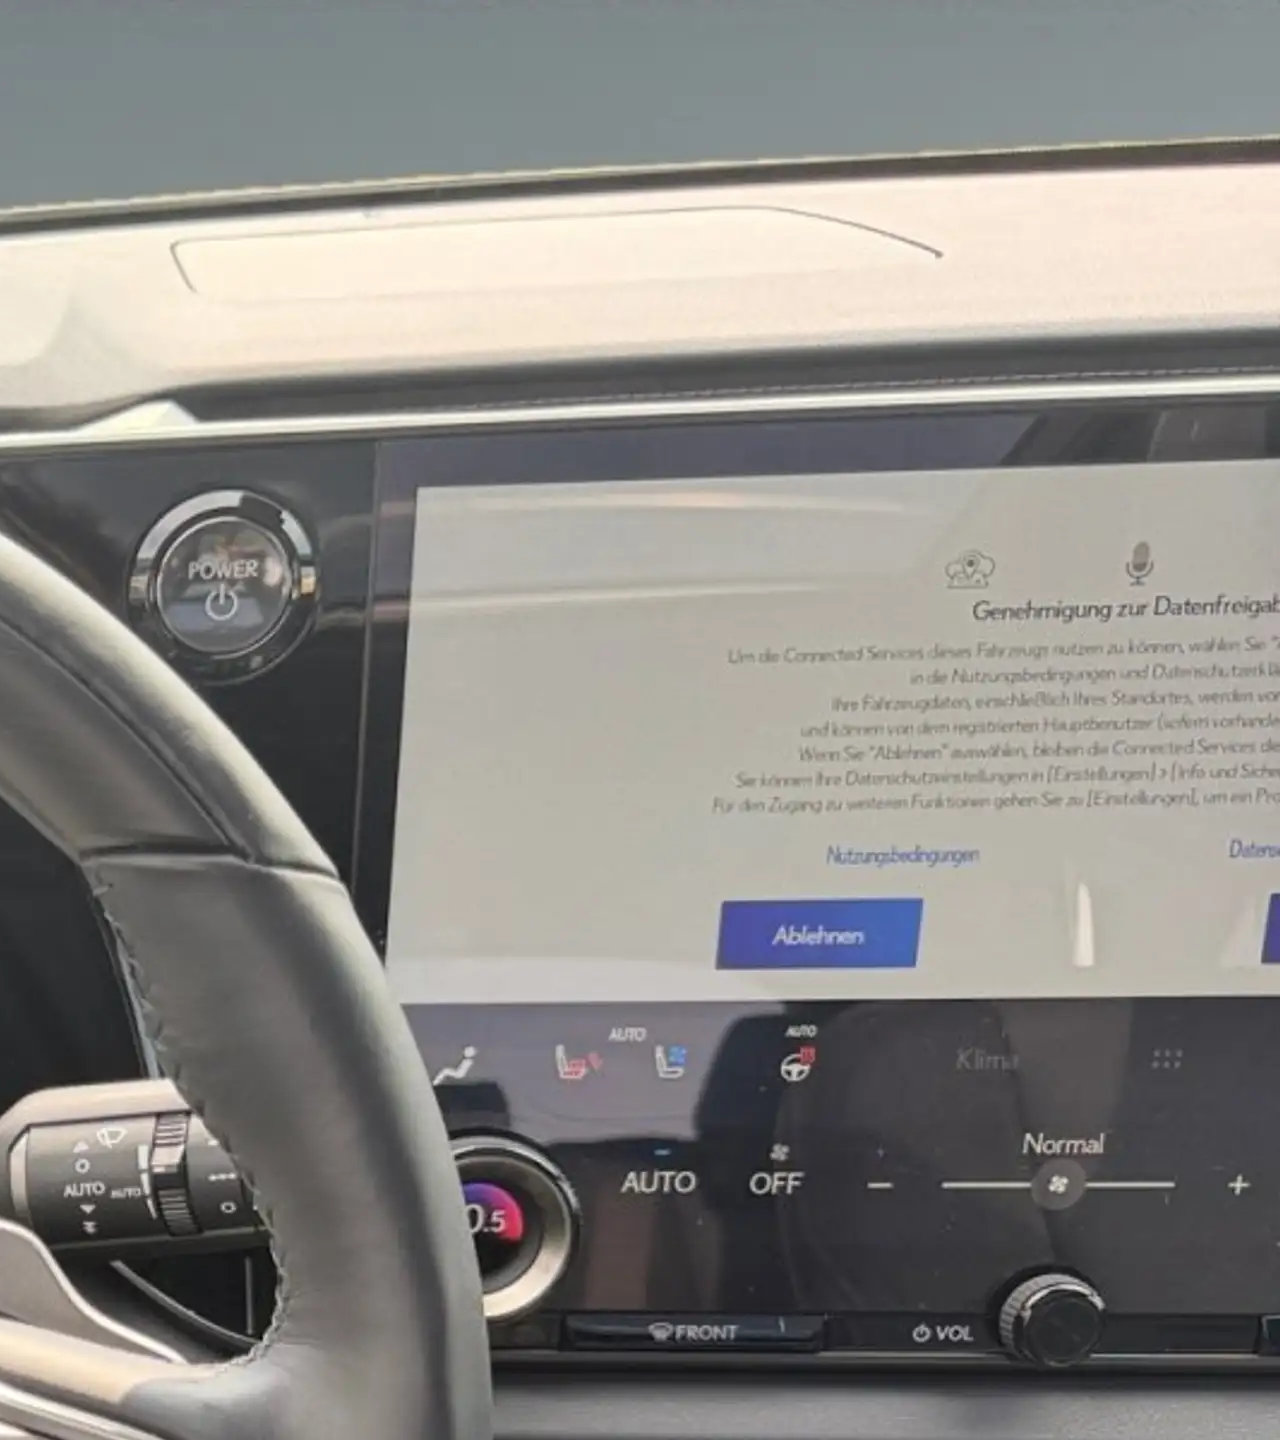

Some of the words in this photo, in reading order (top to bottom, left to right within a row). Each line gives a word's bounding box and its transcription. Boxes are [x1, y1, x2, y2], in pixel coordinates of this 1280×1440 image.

[188, 558, 259, 580] POWER
[972, 599, 1112, 623] Genehmigung
[1116, 602, 1148, 618] zur
[783, 646, 864, 664] Connected
[866, 644, 924, 661] Services
[927, 642, 973, 659] dieses
[1052, 642, 1104, 656] nutzen
[1107, 643, 1124, 656] zu
[1188, 637, 1241, 652] wählen
[951, 666, 1117, 685] Nutzungsbedingungen
[1119, 664, 1150, 680] und
[975, 690, 1071, 709] einschließlich
[1073, 690, 1109, 707] Ihres
[1197, 690, 1254, 705] werden
[800, 721, 830, 738] und
[1042, 716, 1153, 736] Hauptbenutzer
[799, 745, 841, 763] Wenn
[1032, 738, 1085, 758] bleiben
[1111, 738, 1195, 757] Connected
[1196, 736, 1257, 756] Services
[760, 771, 814, 788] können
[844, 767, 1030, 788] Datenschutzeinstellungen
[1208, 763, 1238, 779] und
[768, 796, 824, 815] Zugang
[846, 794, 909, 812] weiteren
[910, 792, 992, 811] Funktionen
[994, 791, 1039, 811] gehen
[826, 844, 981, 869] Nutzungsbedingungen
[771, 923, 865, 947] Ablehnen
[608, 1026, 647, 1042] AUTO
[785, 1024, 818, 1038] AUTO
[1022, 1131, 1107, 1156] Normal
[63, 1180, 107, 1199] AUTO
[109, 1186, 143, 1200] AUTO
[621, 1169, 698, 1196] AUTO
[748, 1169, 805, 1197] OFF
[675, 1322, 738, 1343] FRONT
[935, 1324, 975, 1343] VOL
